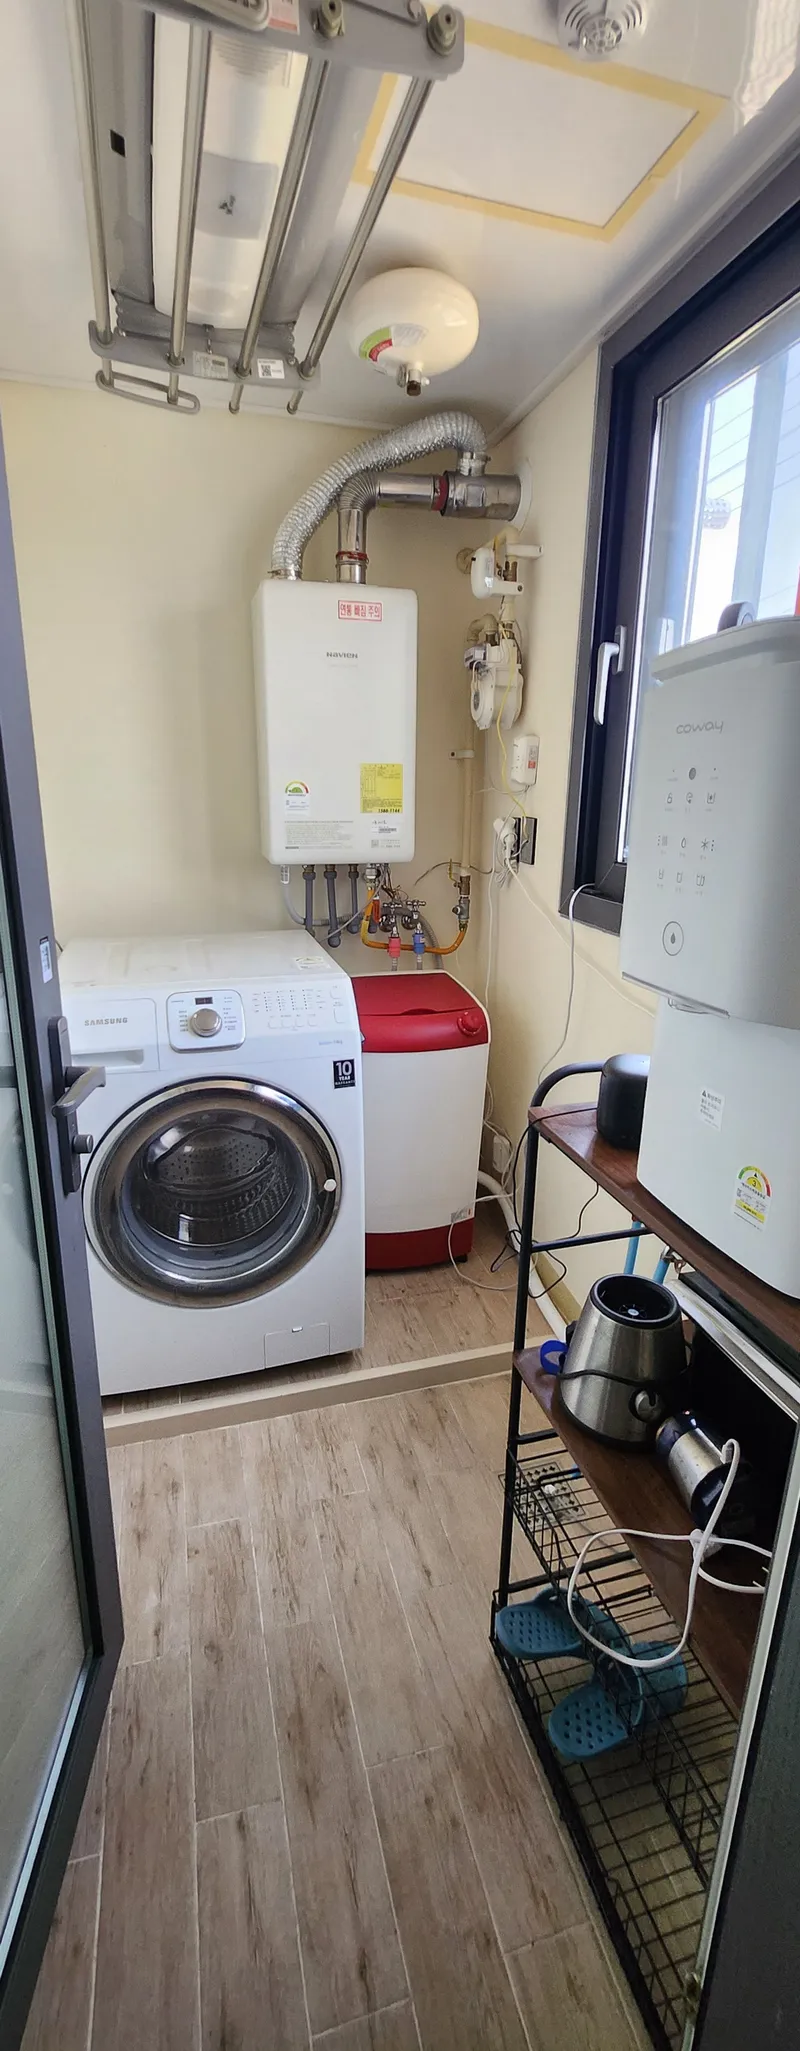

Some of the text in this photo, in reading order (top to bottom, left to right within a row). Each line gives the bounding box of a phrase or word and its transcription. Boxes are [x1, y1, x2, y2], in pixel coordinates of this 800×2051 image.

[340, 603, 352, 617] 연통
[368, 605, 380, 618] 주의
[676, 720, 724, 735] coway
[84, 1017, 128, 1027] SAMSUNG
[335, 1060, 353, 1076] 10
[752, 1179, 757, 1187] 3
